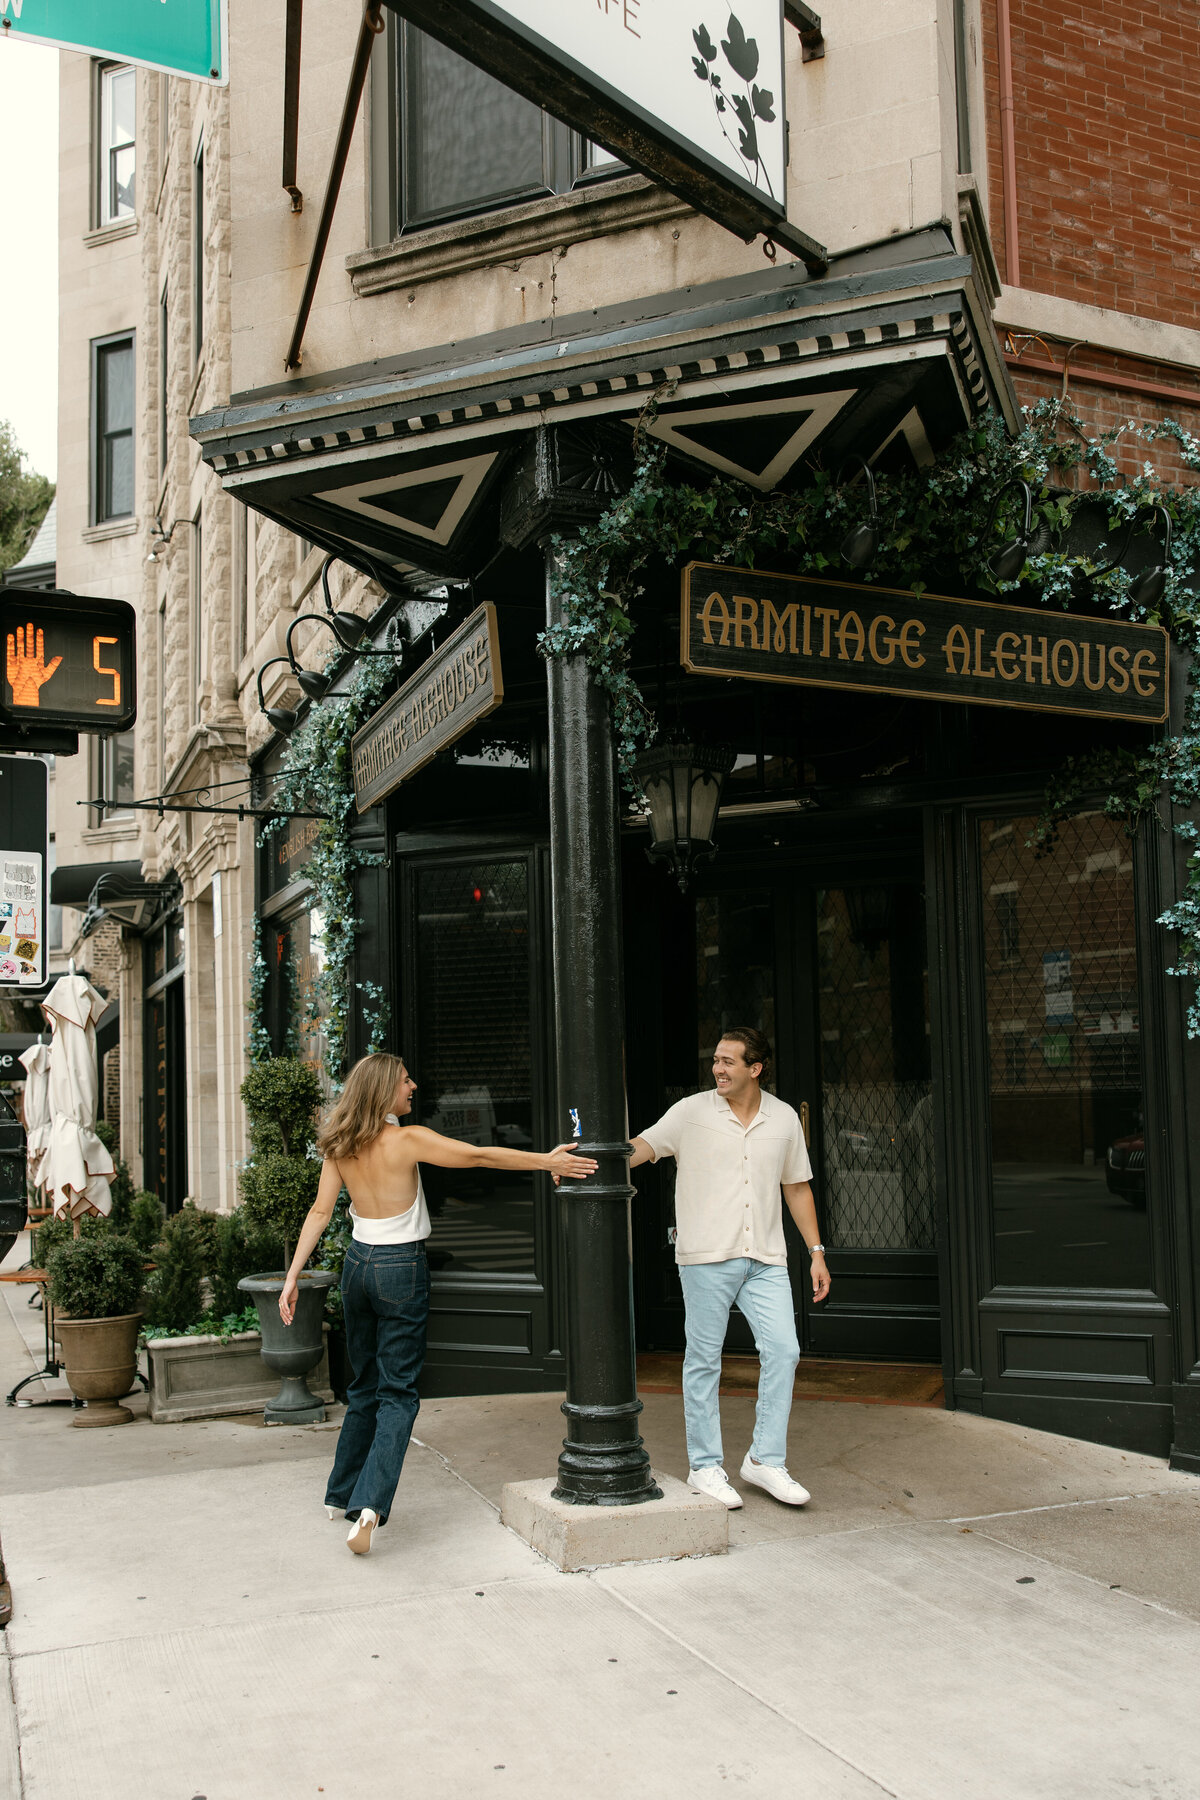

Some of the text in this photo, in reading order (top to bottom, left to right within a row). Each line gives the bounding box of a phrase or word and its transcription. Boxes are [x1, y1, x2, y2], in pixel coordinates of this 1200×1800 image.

[93, 636, 121, 706] 5
[696, 591, 1160, 697] ARMITAGE ALEHOUSE
[355, 634, 488, 791] ARMITAGE ALEHOUSE
